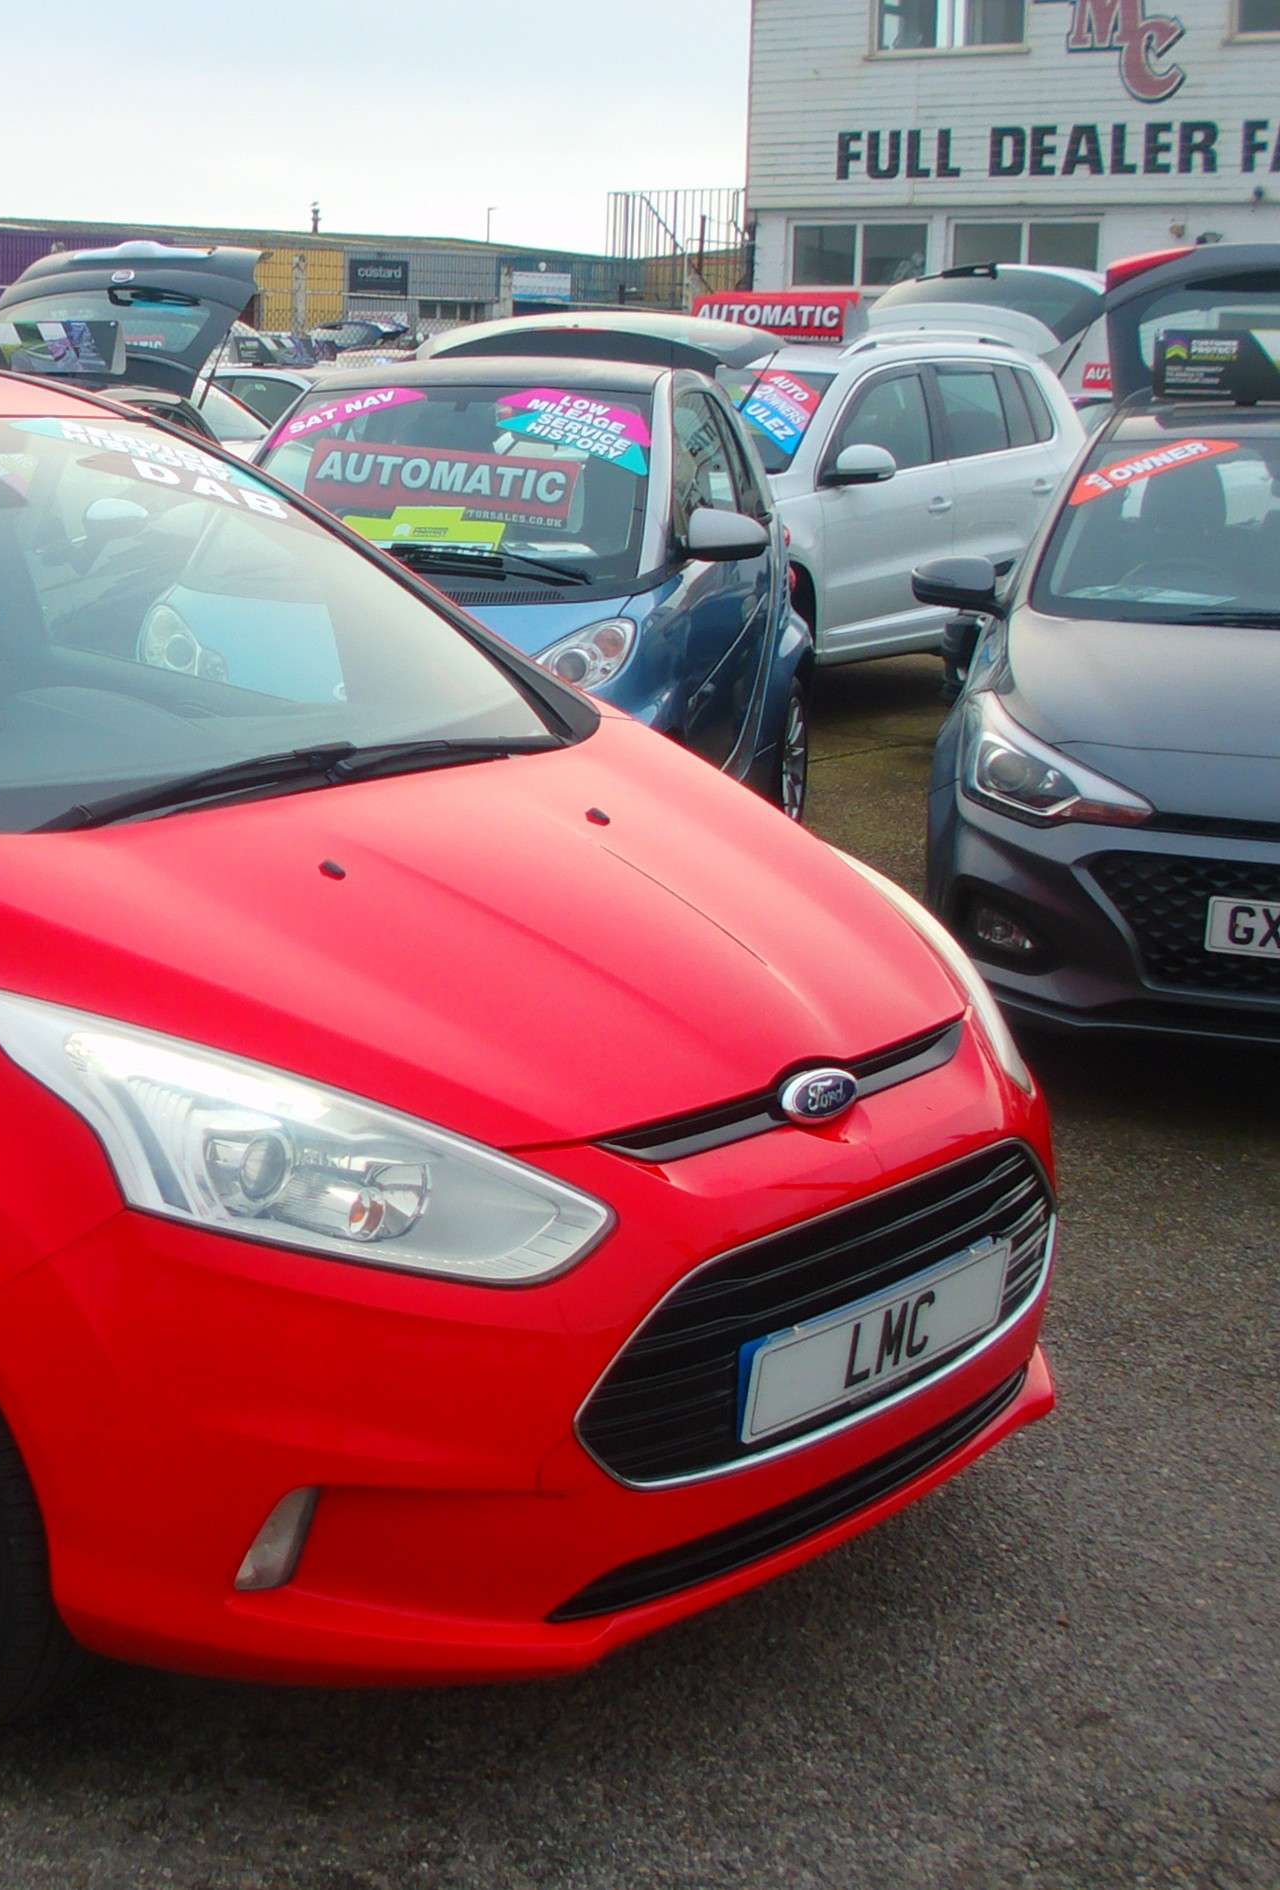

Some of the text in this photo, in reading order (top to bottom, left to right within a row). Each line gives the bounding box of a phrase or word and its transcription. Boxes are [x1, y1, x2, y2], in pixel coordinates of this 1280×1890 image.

[1033, 0, 1186, 102] MC
[836, 119, 1280, 180] FULL DEALER F
[357, 266, 402, 280] custard
[697, 303, 841, 328] AUTOMATIC
[559, 395, 611, 416] LOW
[769, 375, 809, 402] AUTO
[289, 390, 398, 434] SAT NAV
[526, 398, 627, 435] MILEAGE
[746, 402, 796, 441] ULEZ
[525, 421, 624, 460] HISTORY
[536, 412, 633, 452] SERVICE
[315, 450, 566, 503] AUTOMATIC
[1109, 442, 1210, 480] OWNER
[807, 1078, 847, 1113] Ford
[843, 1290, 937, 1390] LMC
